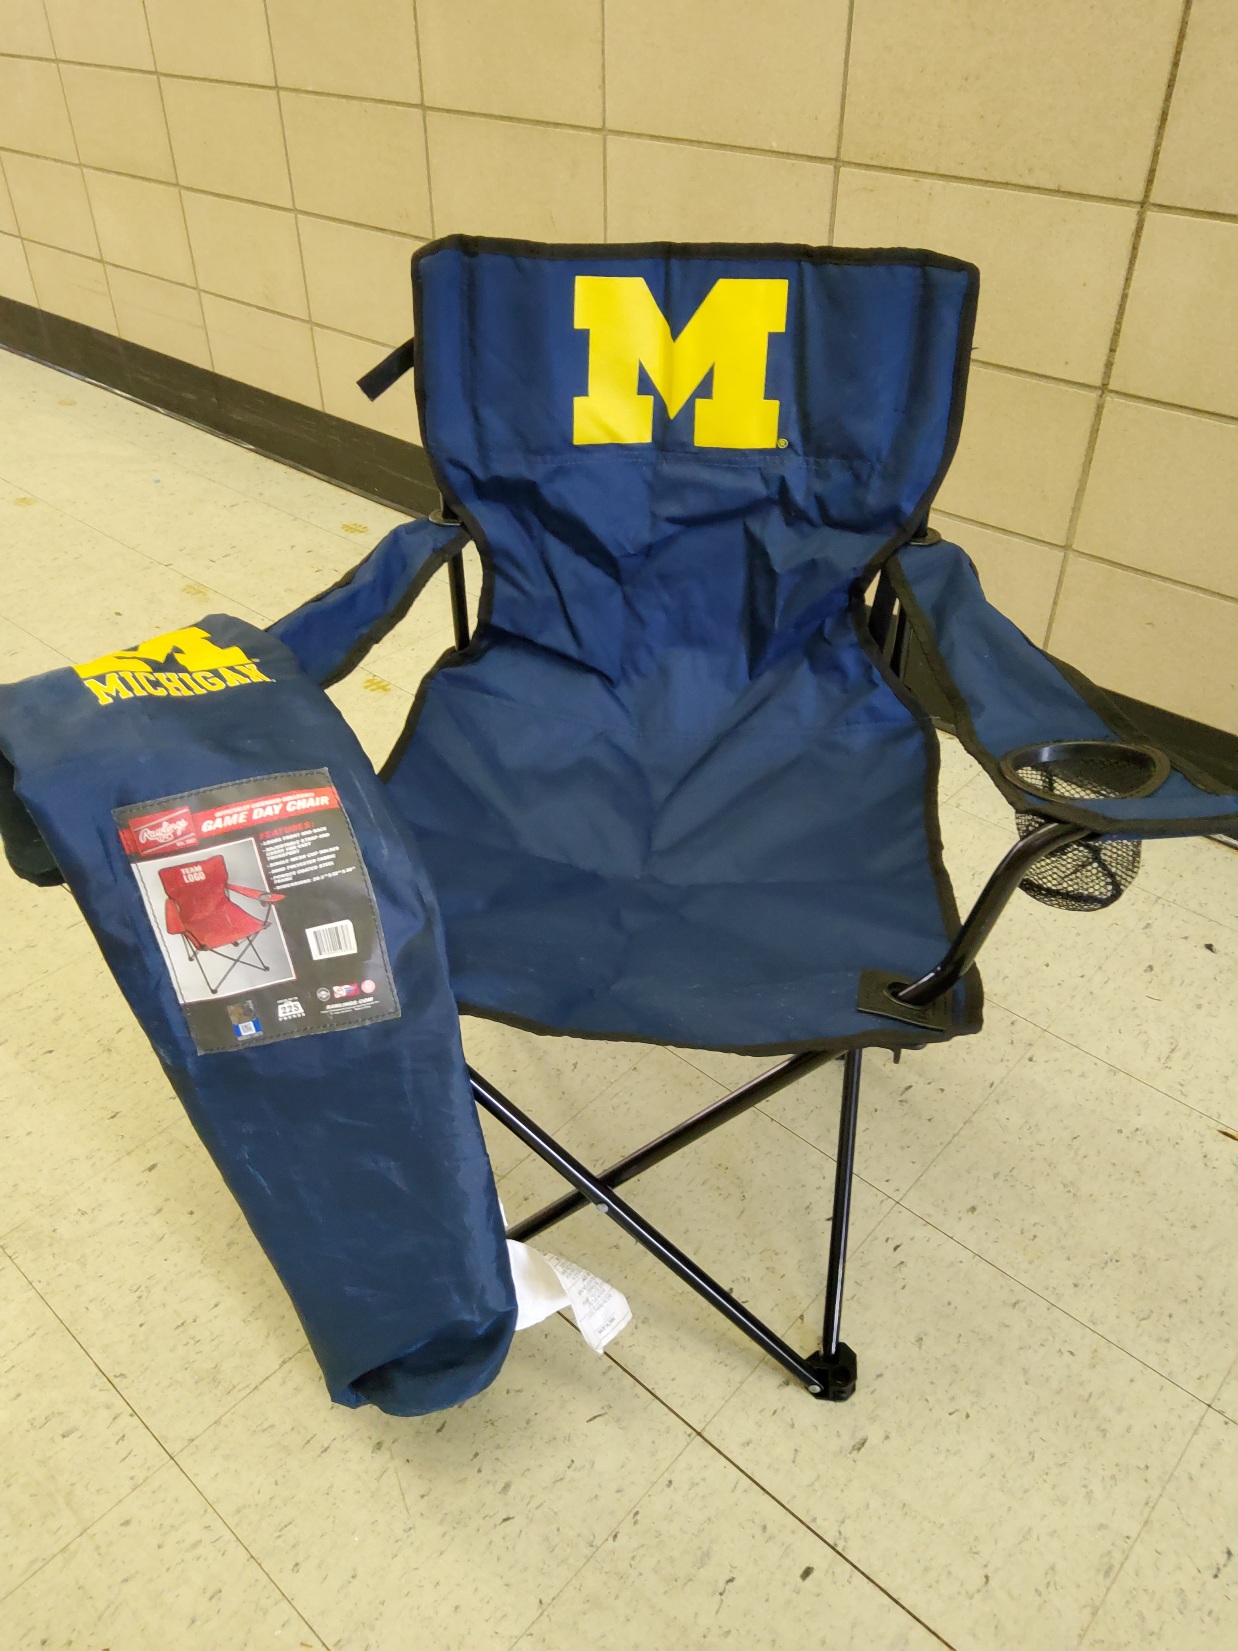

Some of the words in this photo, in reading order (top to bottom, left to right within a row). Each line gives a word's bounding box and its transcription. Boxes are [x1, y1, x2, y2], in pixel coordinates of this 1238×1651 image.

[573, 275, 789, 449] M
[83, 663, 272, 705] MICHIGAN
[201, 811, 249, 832] GAME
[252, 803, 283, 820] DAY
[286, 796, 330, 812] CHAIR
[138, 818, 189, 844] Rawlings
[180, 865, 203, 874] TEAM
[183, 871, 206, 883] LOGO
[281, 1003, 300, 1014] 225
